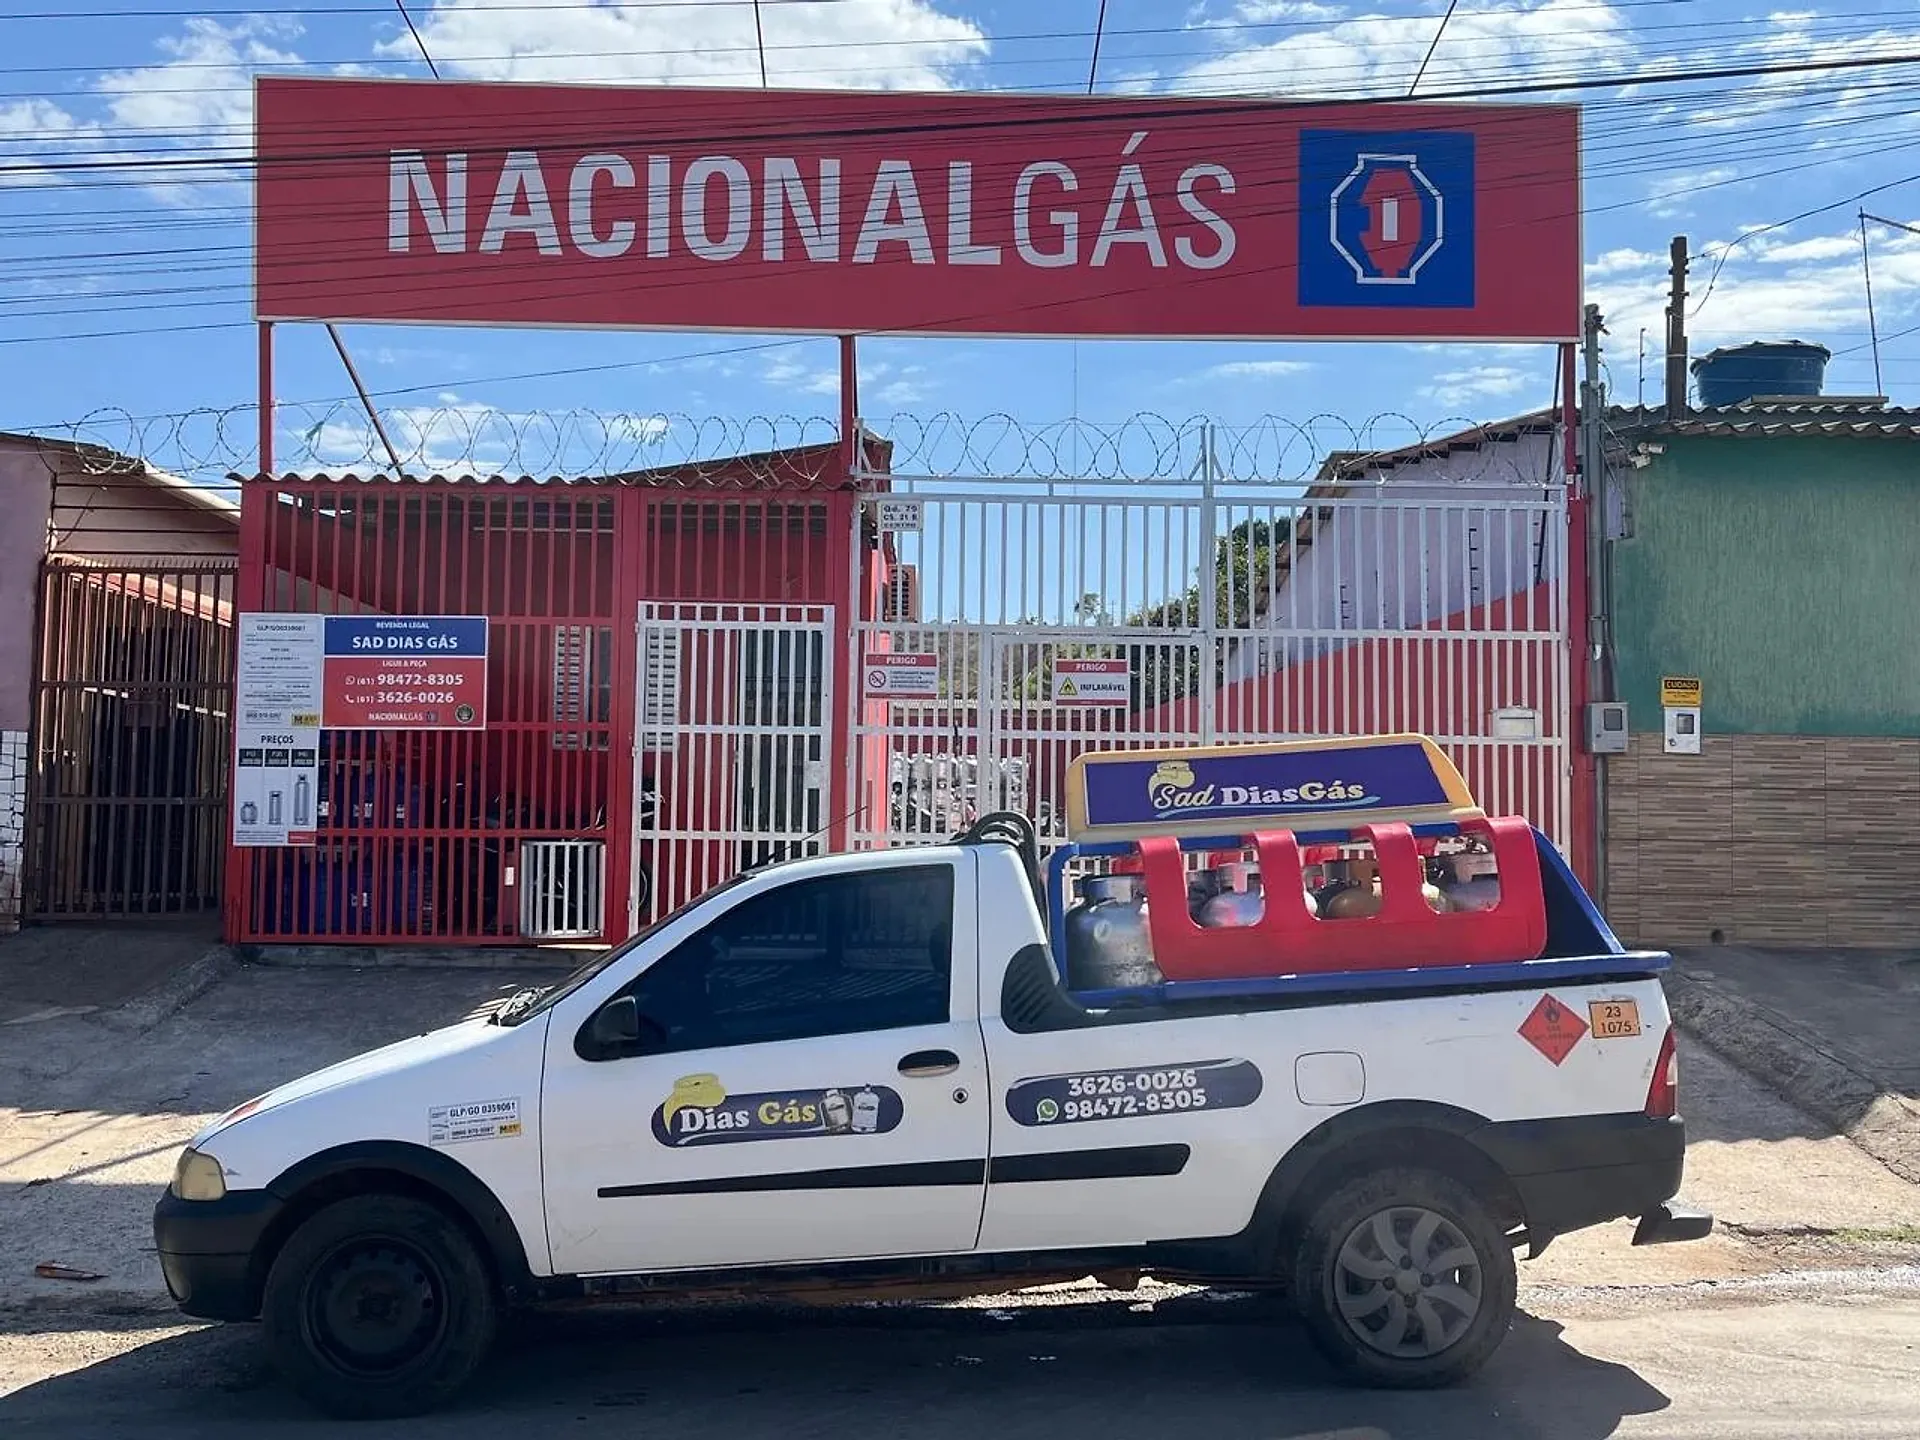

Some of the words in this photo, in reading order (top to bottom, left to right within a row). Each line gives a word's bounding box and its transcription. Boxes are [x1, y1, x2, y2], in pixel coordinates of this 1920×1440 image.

[387, 131, 1238, 270] NACIONALGÁS
[376, 621, 407, 629] REVENDA
[409, 621, 430, 629] LEGAL
[352, 636, 384, 649] SAD
[387, 636, 423, 649] DIAS
[427, 634, 458, 649] GÁS
[410, 660, 427, 668] PEÇA
[886, 656, 917, 665] PERIGO
[1075, 663, 1107, 672] PERIGO
[377, 674, 464, 686] 98472-8305
[1080, 682, 1125, 691] INFLAMÁVEL
[376, 692, 455, 704] 3626-0026
[261, 735, 294, 745] PREÇOS
[1153, 784, 1215, 810] Sad
[1605, 1006, 1622, 1018] 23
[1601, 1022, 1632, 1034] 1075
[1068, 1068, 1198, 1097] 3626-0026
[1064, 1088, 1207, 1120] 98472-8305
[680, 1107, 750, 1133] Dias
[757, 1099, 817, 1125] Gás
